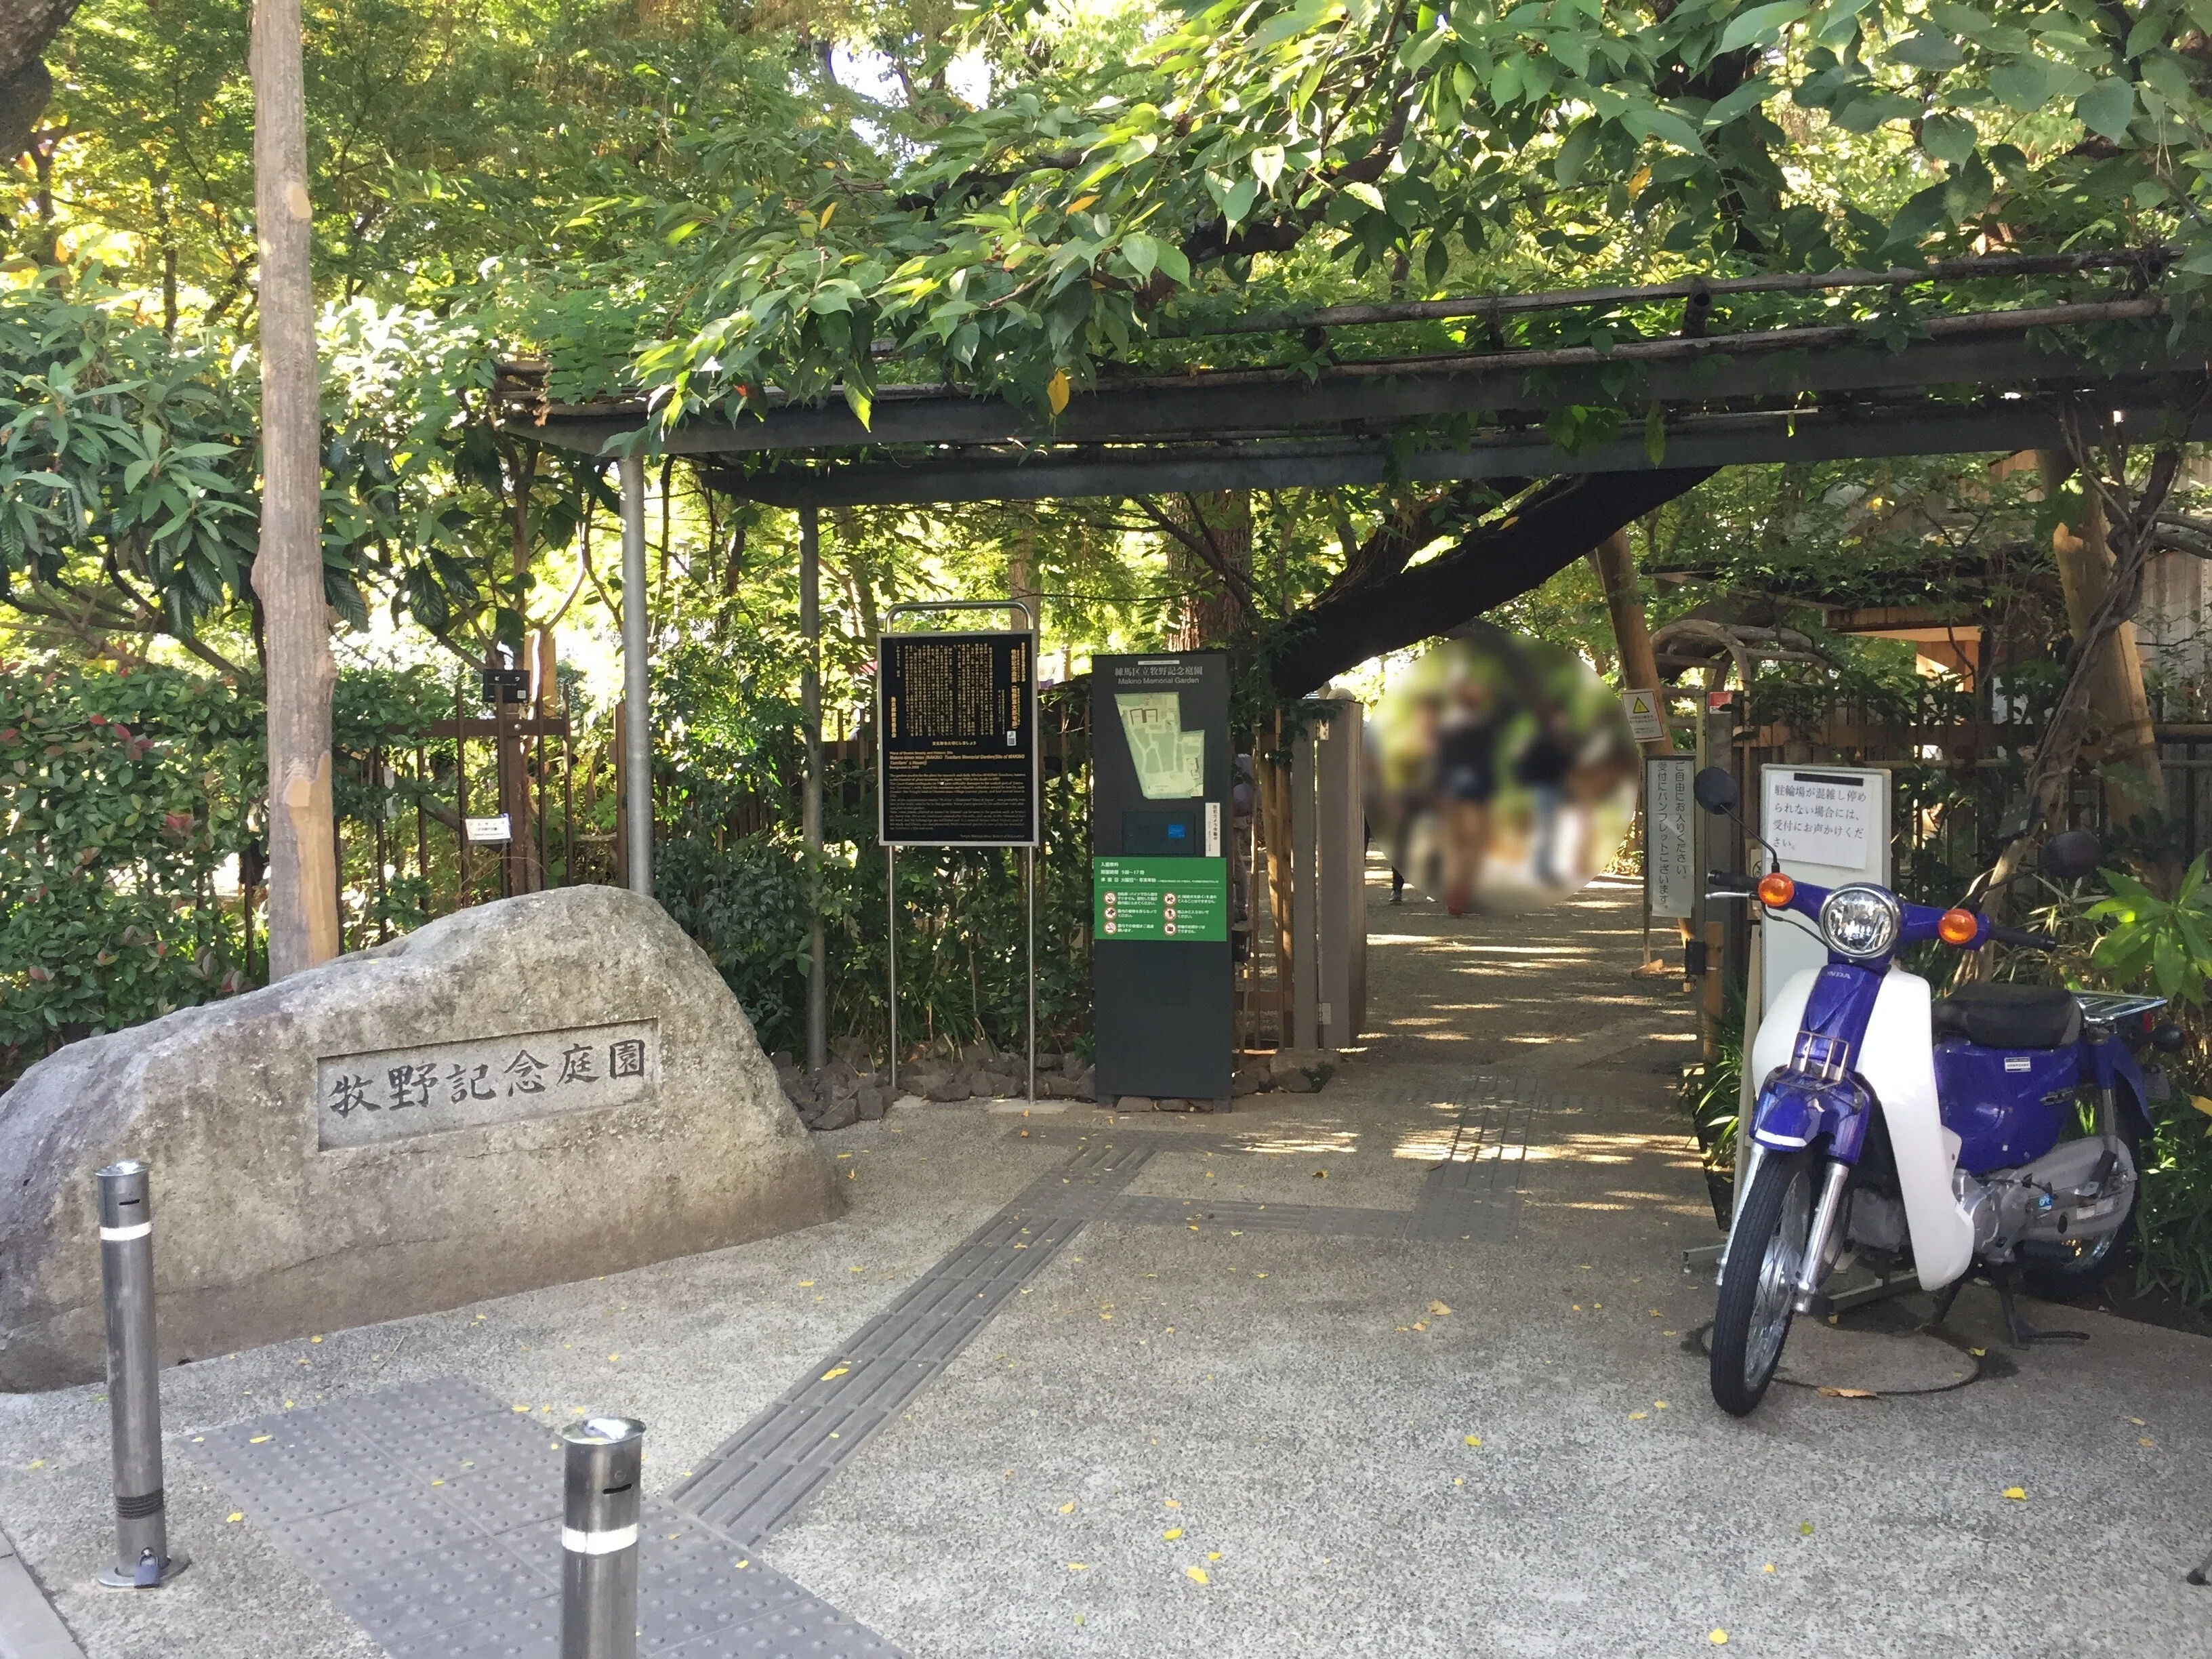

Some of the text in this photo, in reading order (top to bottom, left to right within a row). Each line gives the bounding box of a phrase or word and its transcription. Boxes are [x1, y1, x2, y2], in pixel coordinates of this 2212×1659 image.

[1115, 666, 1203, 676] 練馬区立牧野記念庭園
[1774, 784, 1866, 802] 駐輪場が混雑し停め
[1675, 761, 1687, 880] ご自由にお入りください。
[1774, 803, 1859, 821] られない場合には、
[1657, 761, 1669, 909] 受付にパンフレットございます。
[1773, 819, 1864, 839] 受付にお声かけくだ
[1774, 837, 1795, 850] さい。
[329, 1039, 646, 1119] 牧野記念庭園
